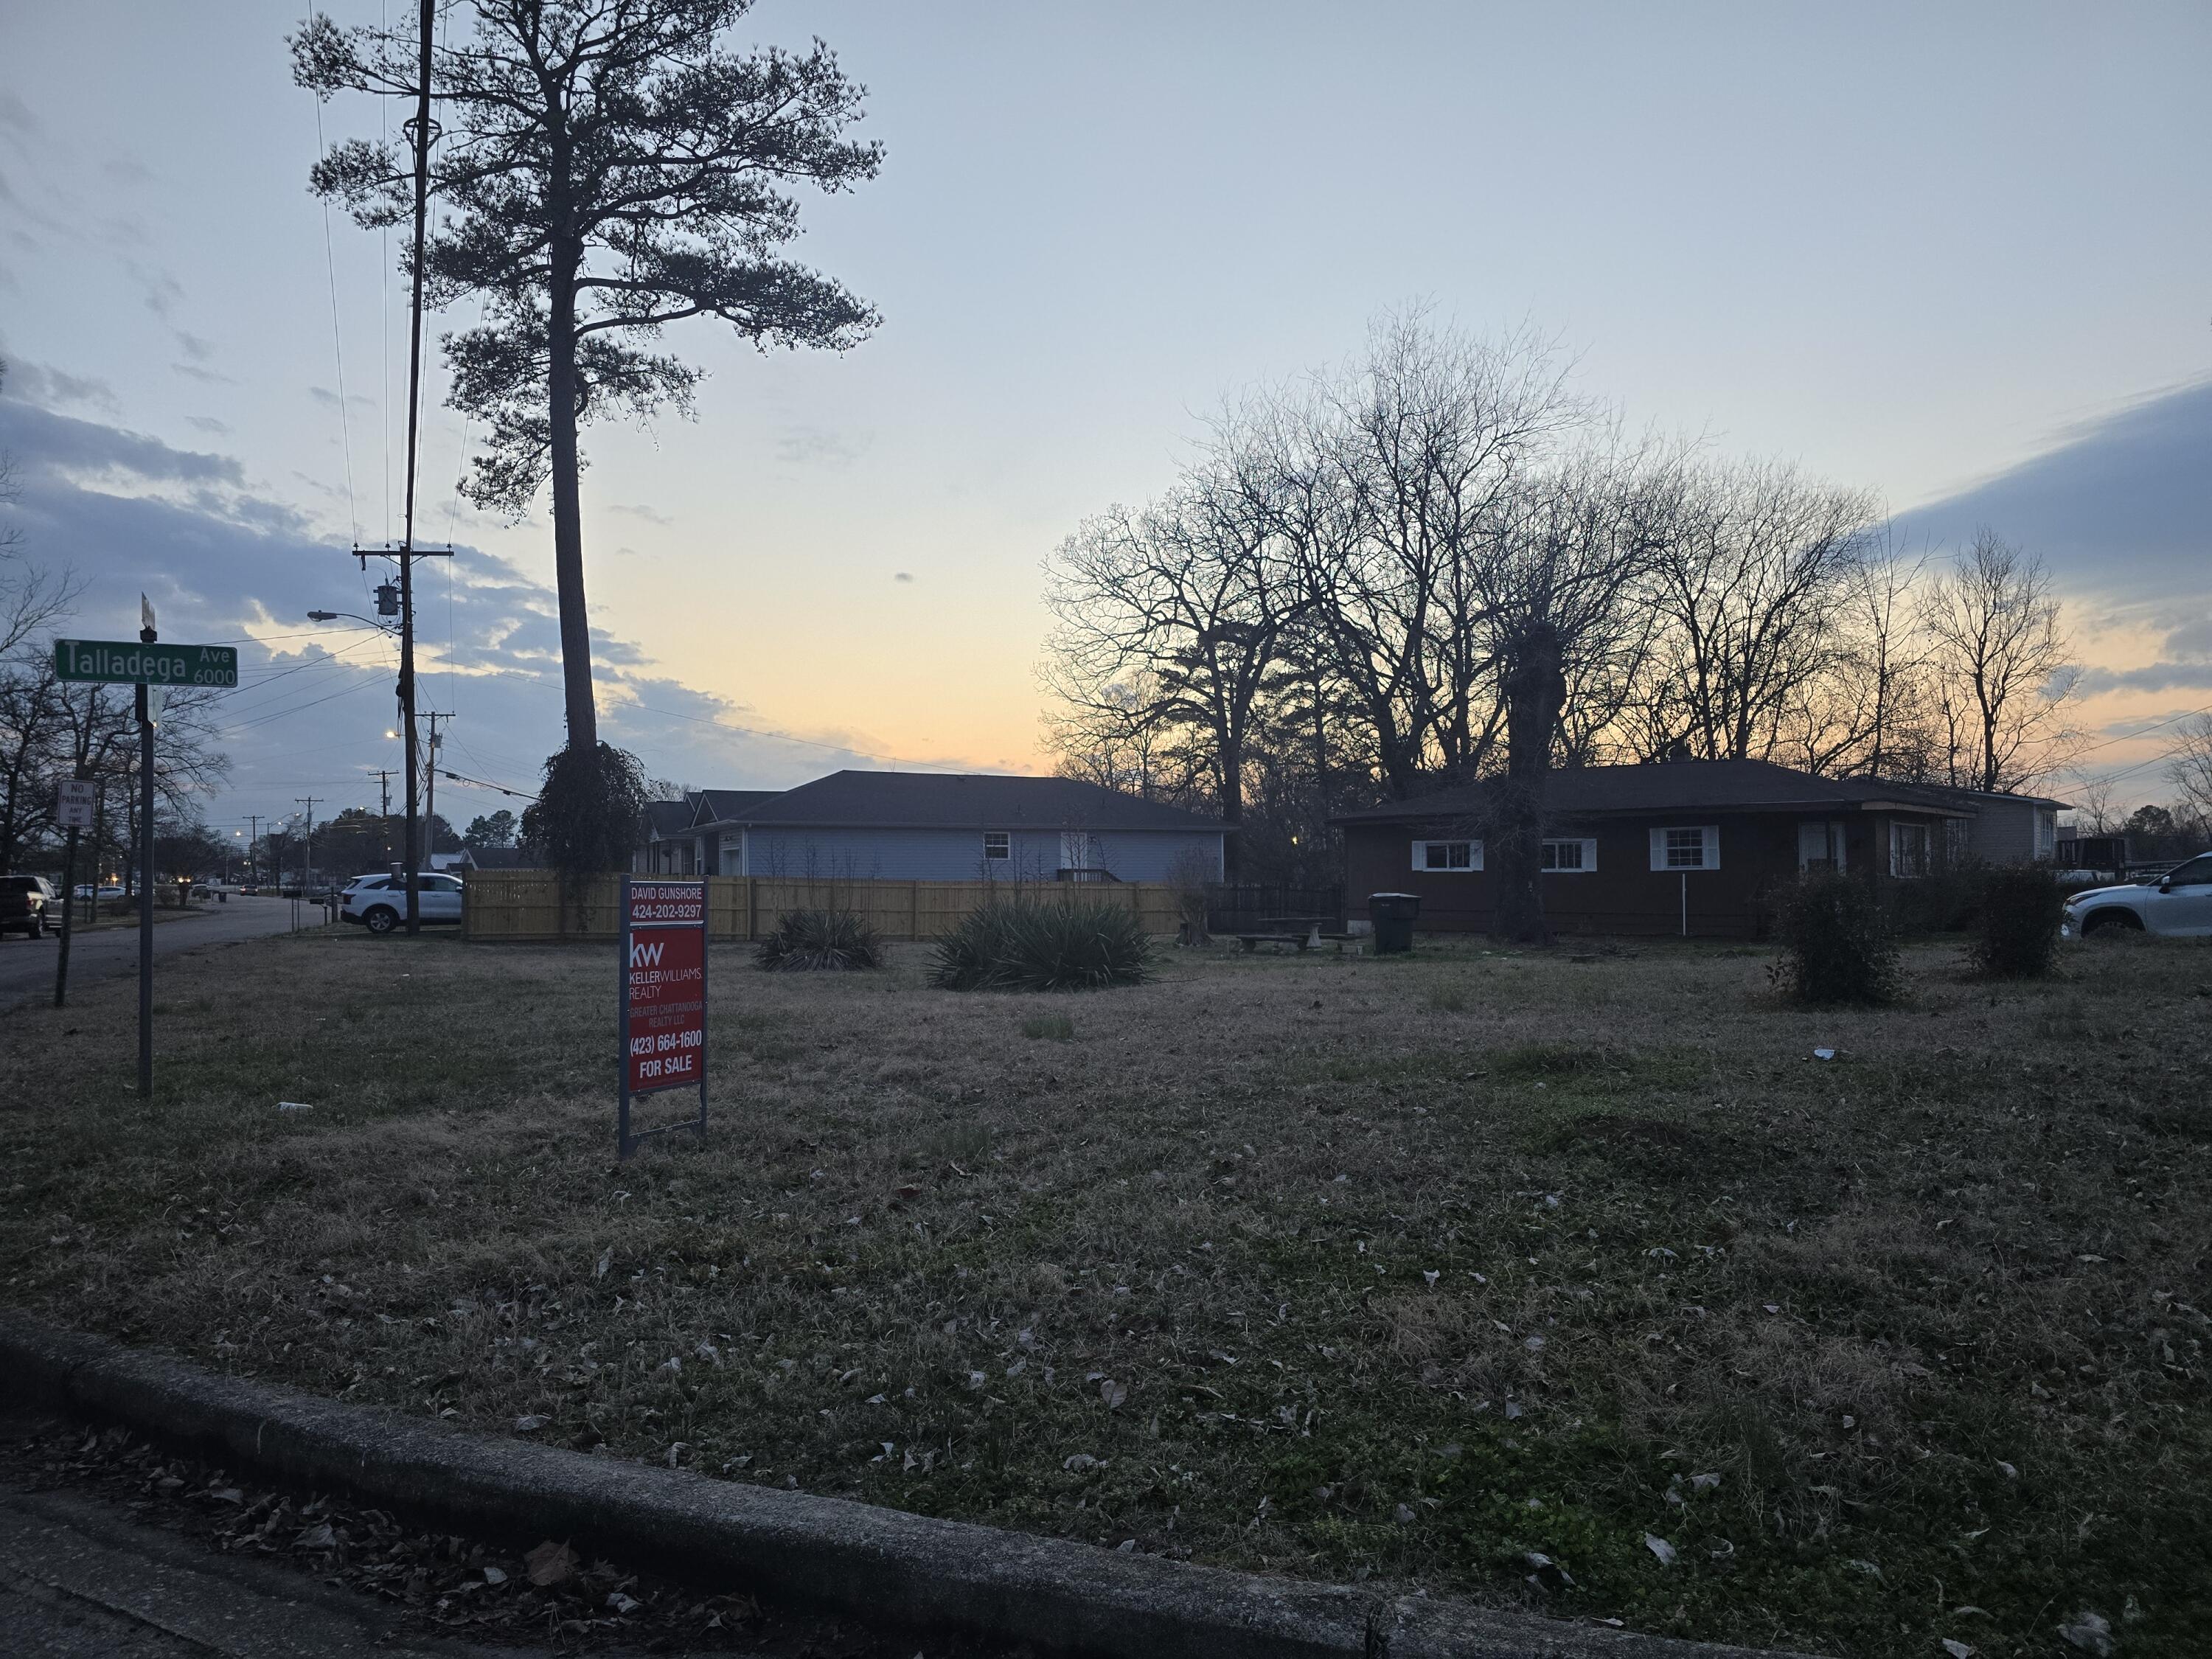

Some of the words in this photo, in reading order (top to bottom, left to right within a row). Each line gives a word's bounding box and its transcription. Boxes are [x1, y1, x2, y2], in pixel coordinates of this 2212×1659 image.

[64, 641, 186, 682] Talladega
[200, 647, 230, 663] Ave
[194, 669, 235, 685] 6000
[71, 784, 83, 793] NO
[62, 796, 91, 805] PARKING
[631, 887, 656, 900] DAVID
[658, 887, 702, 900] GUNSHORE
[632, 904, 702, 919] 424-202-9297
[629, 985, 662, 1000] REALTY
[630, 1005, 658, 1018] GREATER
[659, 1001, 703, 1015] CHATTANOOGA
[648, 1016, 672, 1028] REALTY
[673, 1015, 685, 1025] LLC
[630, 1035, 655, 1057] (423)
[657, 1029, 702, 1052] 664-1600
[639, 1060, 661, 1079] FOR
[664, 1054, 692, 1074] SALE
